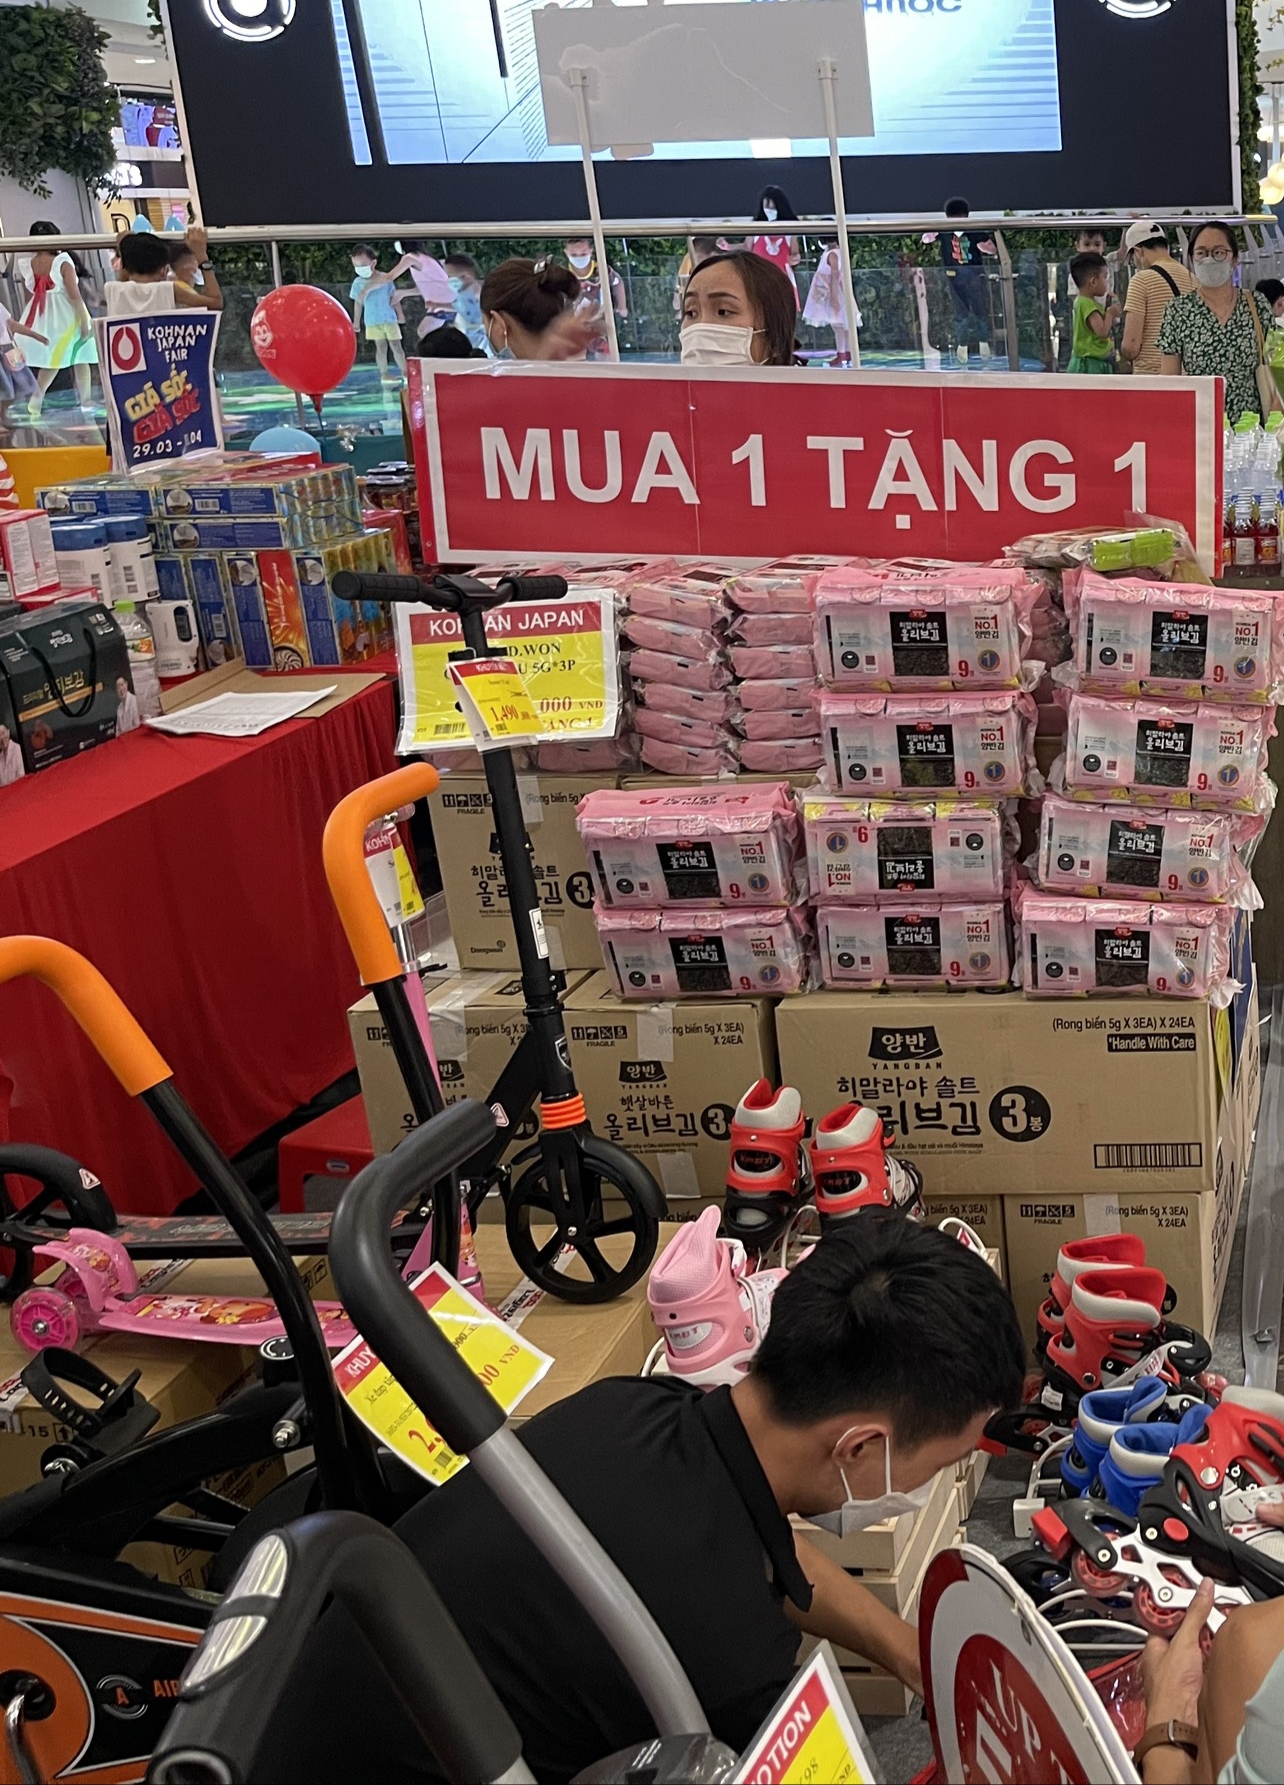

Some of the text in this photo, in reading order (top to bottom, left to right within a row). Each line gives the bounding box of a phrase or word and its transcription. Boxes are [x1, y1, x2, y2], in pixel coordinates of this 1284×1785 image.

[148, 325, 207, 340] KOHNAN
[158, 336, 196, 352] JAPAN
[165, 349, 188, 362] FAIR
[124, 381, 160, 421] GIÁ
[133, 439, 173, 458] 29.03
[480, 427, 1146, 529] MUA 1 TẶNG 1
[430, 609, 584, 636] KOAN JAPAN
[975, 614, 998, 630] NO.1
[1235, 621, 1259, 636] NO.1
[579, 700, 603, 710] VND
[980, 726, 1004, 742] NO.1
[1220, 730, 1243, 745] NO.1
[741, 841, 764, 856] NO.1
[1190, 834, 1214, 848] NO.1
[471, 865, 506, 881] 히말
[476, 880, 563, 908] 올김
[967, 919, 990, 934] NO.1
[751, 936, 775, 950] NO.1
[1176, 936, 1198, 950] NO.1
[685, 1023, 702, 1034] biến
[704, 1023, 714, 1035] 5g
[716, 1023, 723, 1032] X
[724, 1022, 745, 1034] 3EA)
[1052, 1015, 1195, 1032] (Rong biến 5g X 3EA) X 24EA
[714, 1035, 744, 1045] X 24EA
[881, 1033, 927, 1053] 양반
[1148, 1036, 1170, 1050] With
[1171, 1035, 1195, 1049] Care
[626, 1064, 656, 1079] 양반
[872, 1062, 942, 1070] YANGBAN
[837, 1076, 980, 1099] 히말라야 솔트
[620, 1094, 675, 1112] 햇살바른
[848, 1100, 981, 1136] 리브김
[604, 1112, 699, 1141] 올리브김
[932, 1203, 988, 1217] biến 5g X 3EA)
[1131, 1204, 1148, 1216] biến
[1150, 1205, 1160, 1217] 5g
[1161, 1205, 1168, 1216] X
[1169, 1205, 1189, 1217] 3EA)
[1158, 1217, 1187, 1228] X 24EA
[345, 1346, 376, 1378] KHUY
[499, 1344, 520, 1365] VND
[116, 1687, 130, 1705] A
[751, 1700, 812, 1785] OTION
